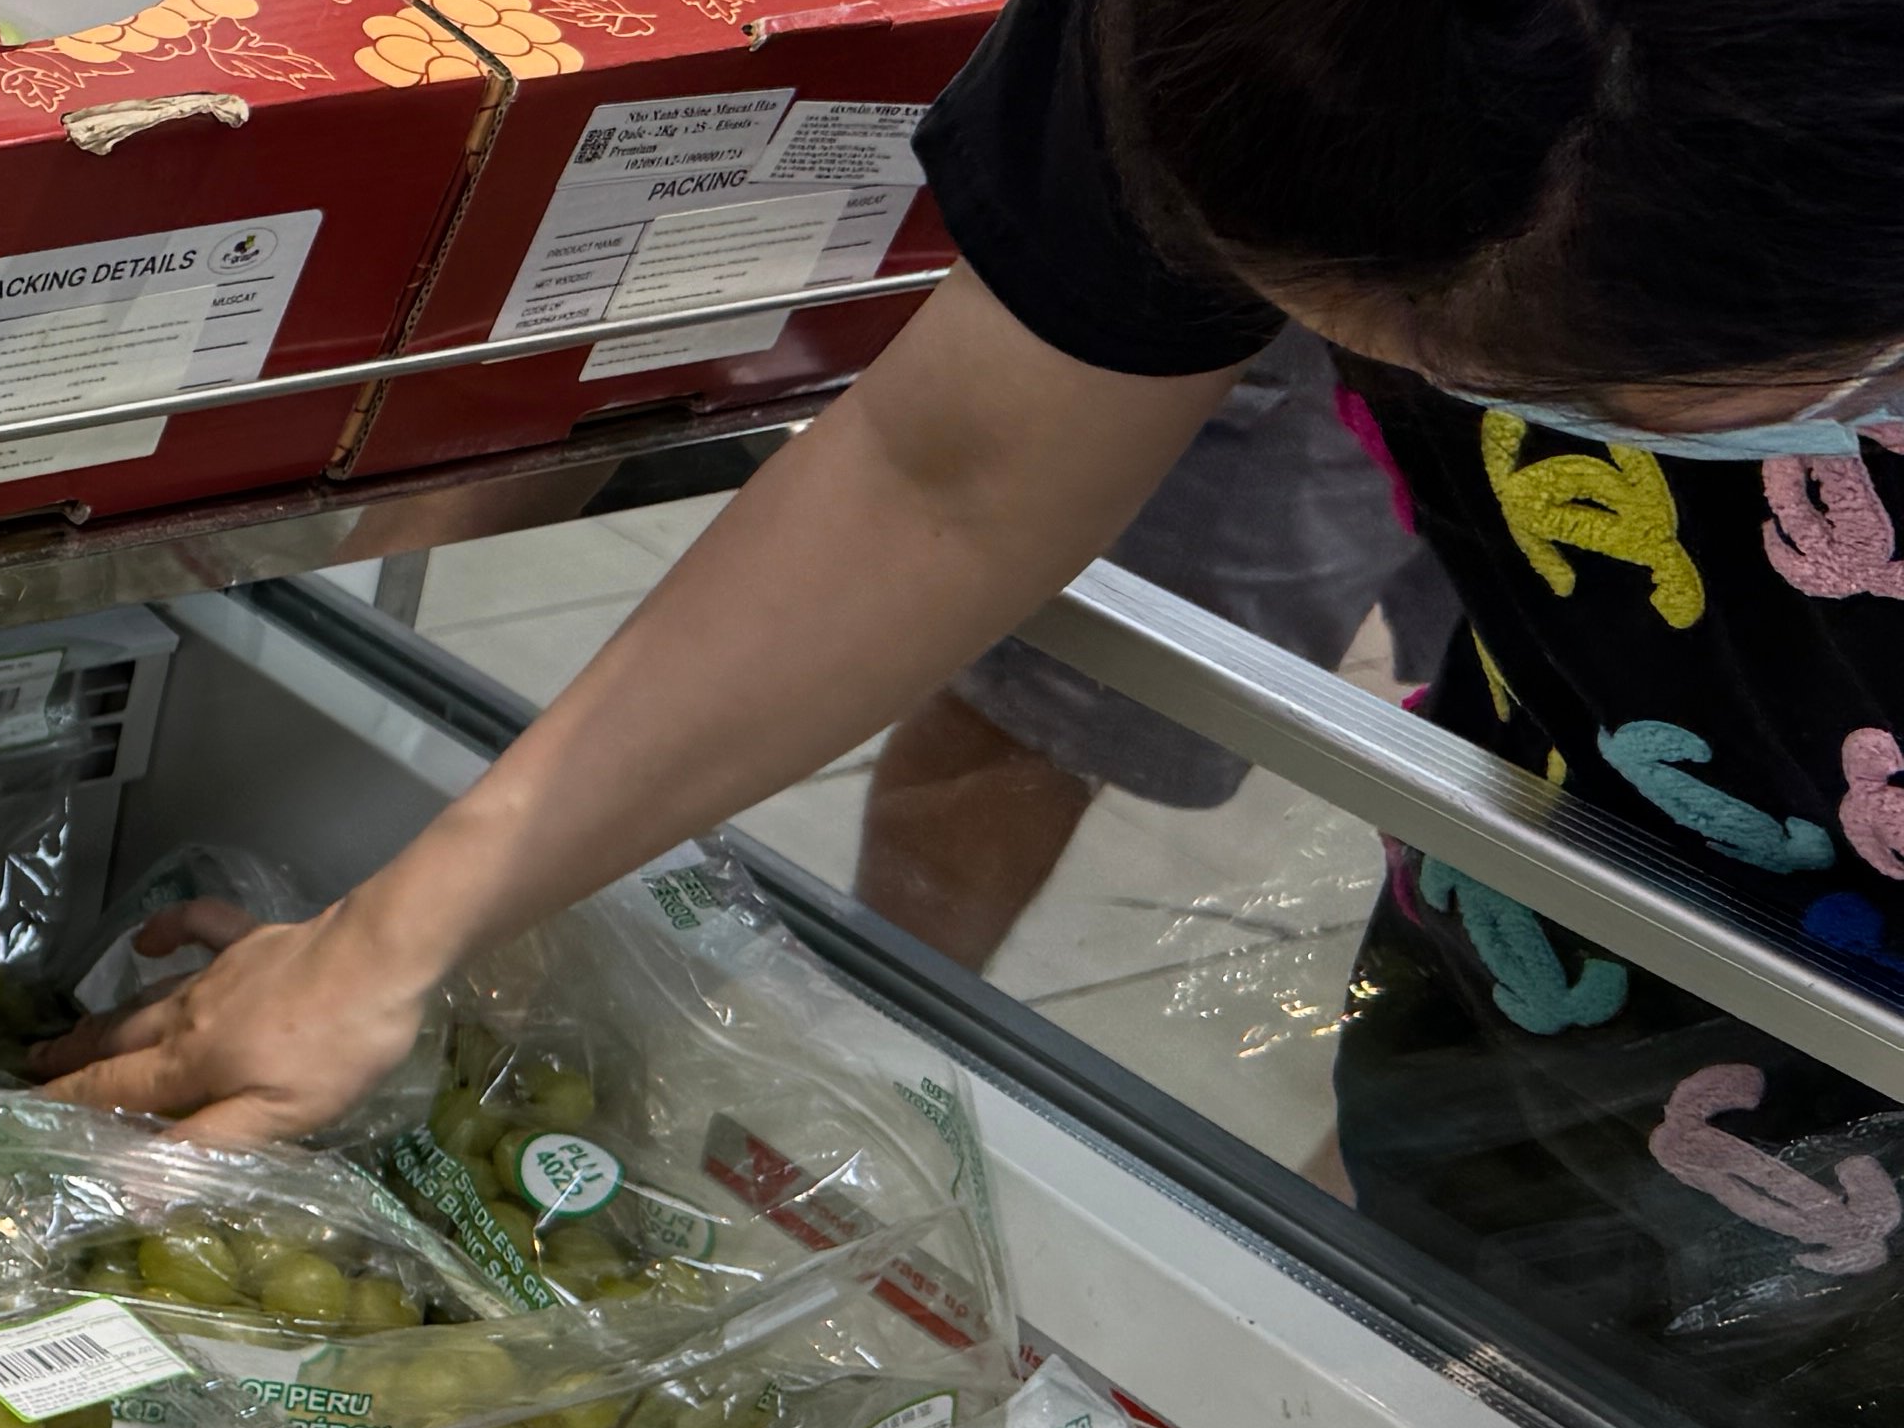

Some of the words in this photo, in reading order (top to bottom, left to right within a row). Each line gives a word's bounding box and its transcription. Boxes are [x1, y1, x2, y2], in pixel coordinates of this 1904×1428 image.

[608, 143, 657, 158] Premium
[647, 169, 749, 201] PACKING
[91, 250, 197, 284] DETAILS
[536, 1149, 584, 1201] 4022
[559, 1143, 603, 1184] PLU
[437, 1186, 486, 1262] BLANC
[454, 1166, 524, 1275] SEEDLESS
[239, 1379, 283, 1404] OF
[287, 1385, 372, 1417] PERU
